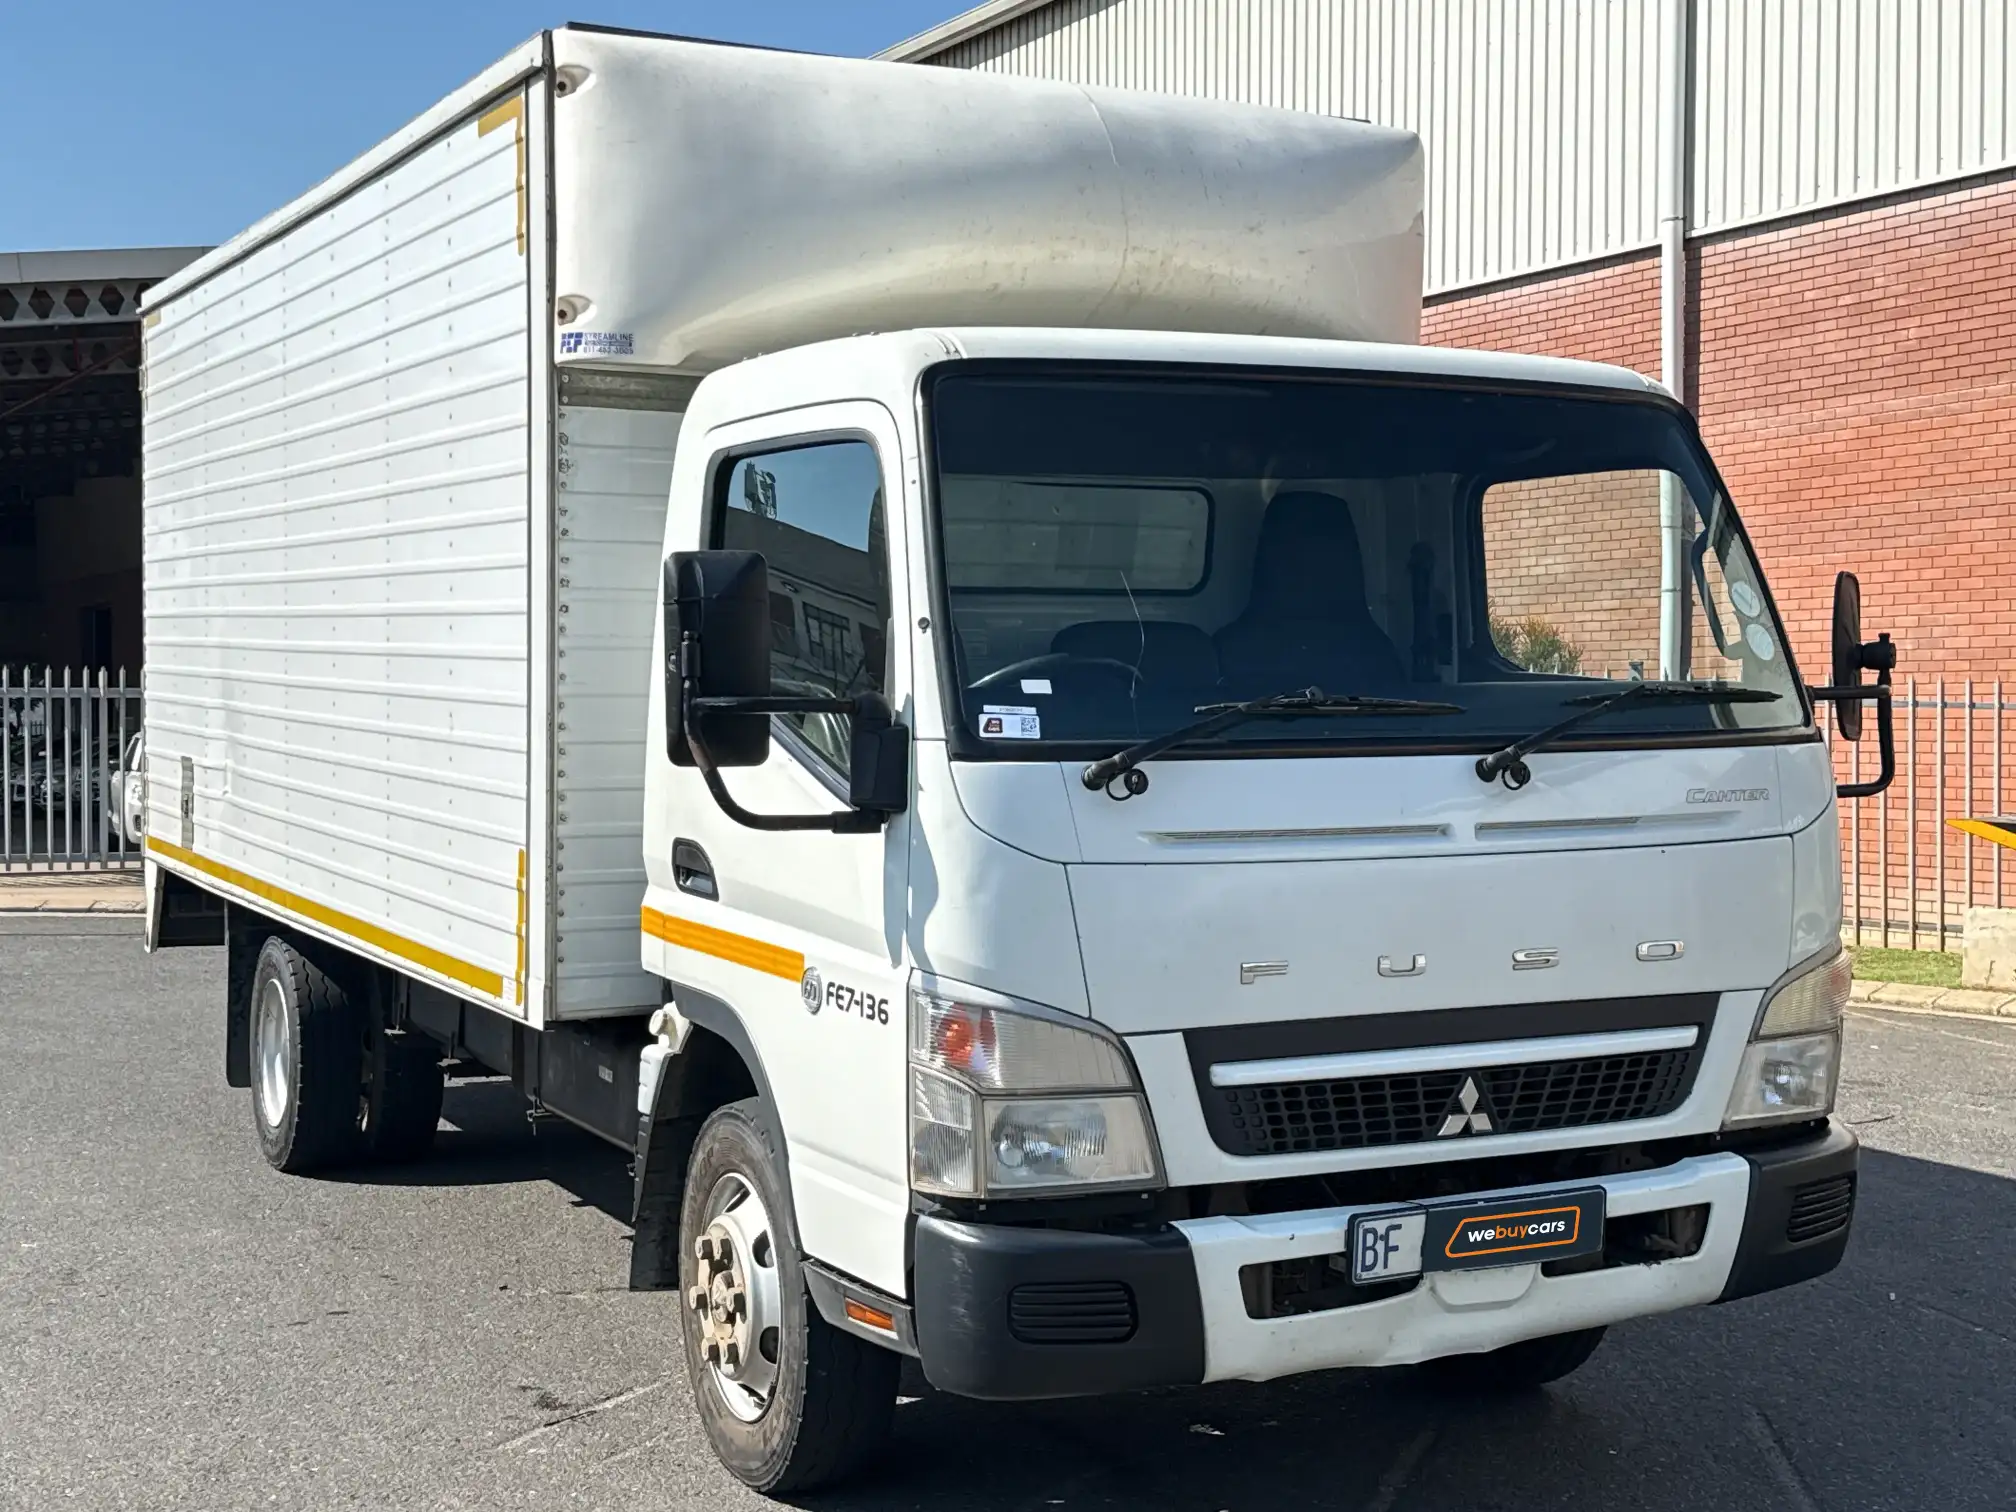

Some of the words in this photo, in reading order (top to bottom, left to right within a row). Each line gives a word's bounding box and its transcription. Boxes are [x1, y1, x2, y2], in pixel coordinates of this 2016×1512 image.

[583, 332, 634, 341] STREAMLINE
[1240, 939, 1685, 985] FUSO
[826, 981, 889, 1025] FE7-136
[1361, 1224, 1402, 1272] BF
[1468, 1220, 1565, 1243] webuycars
